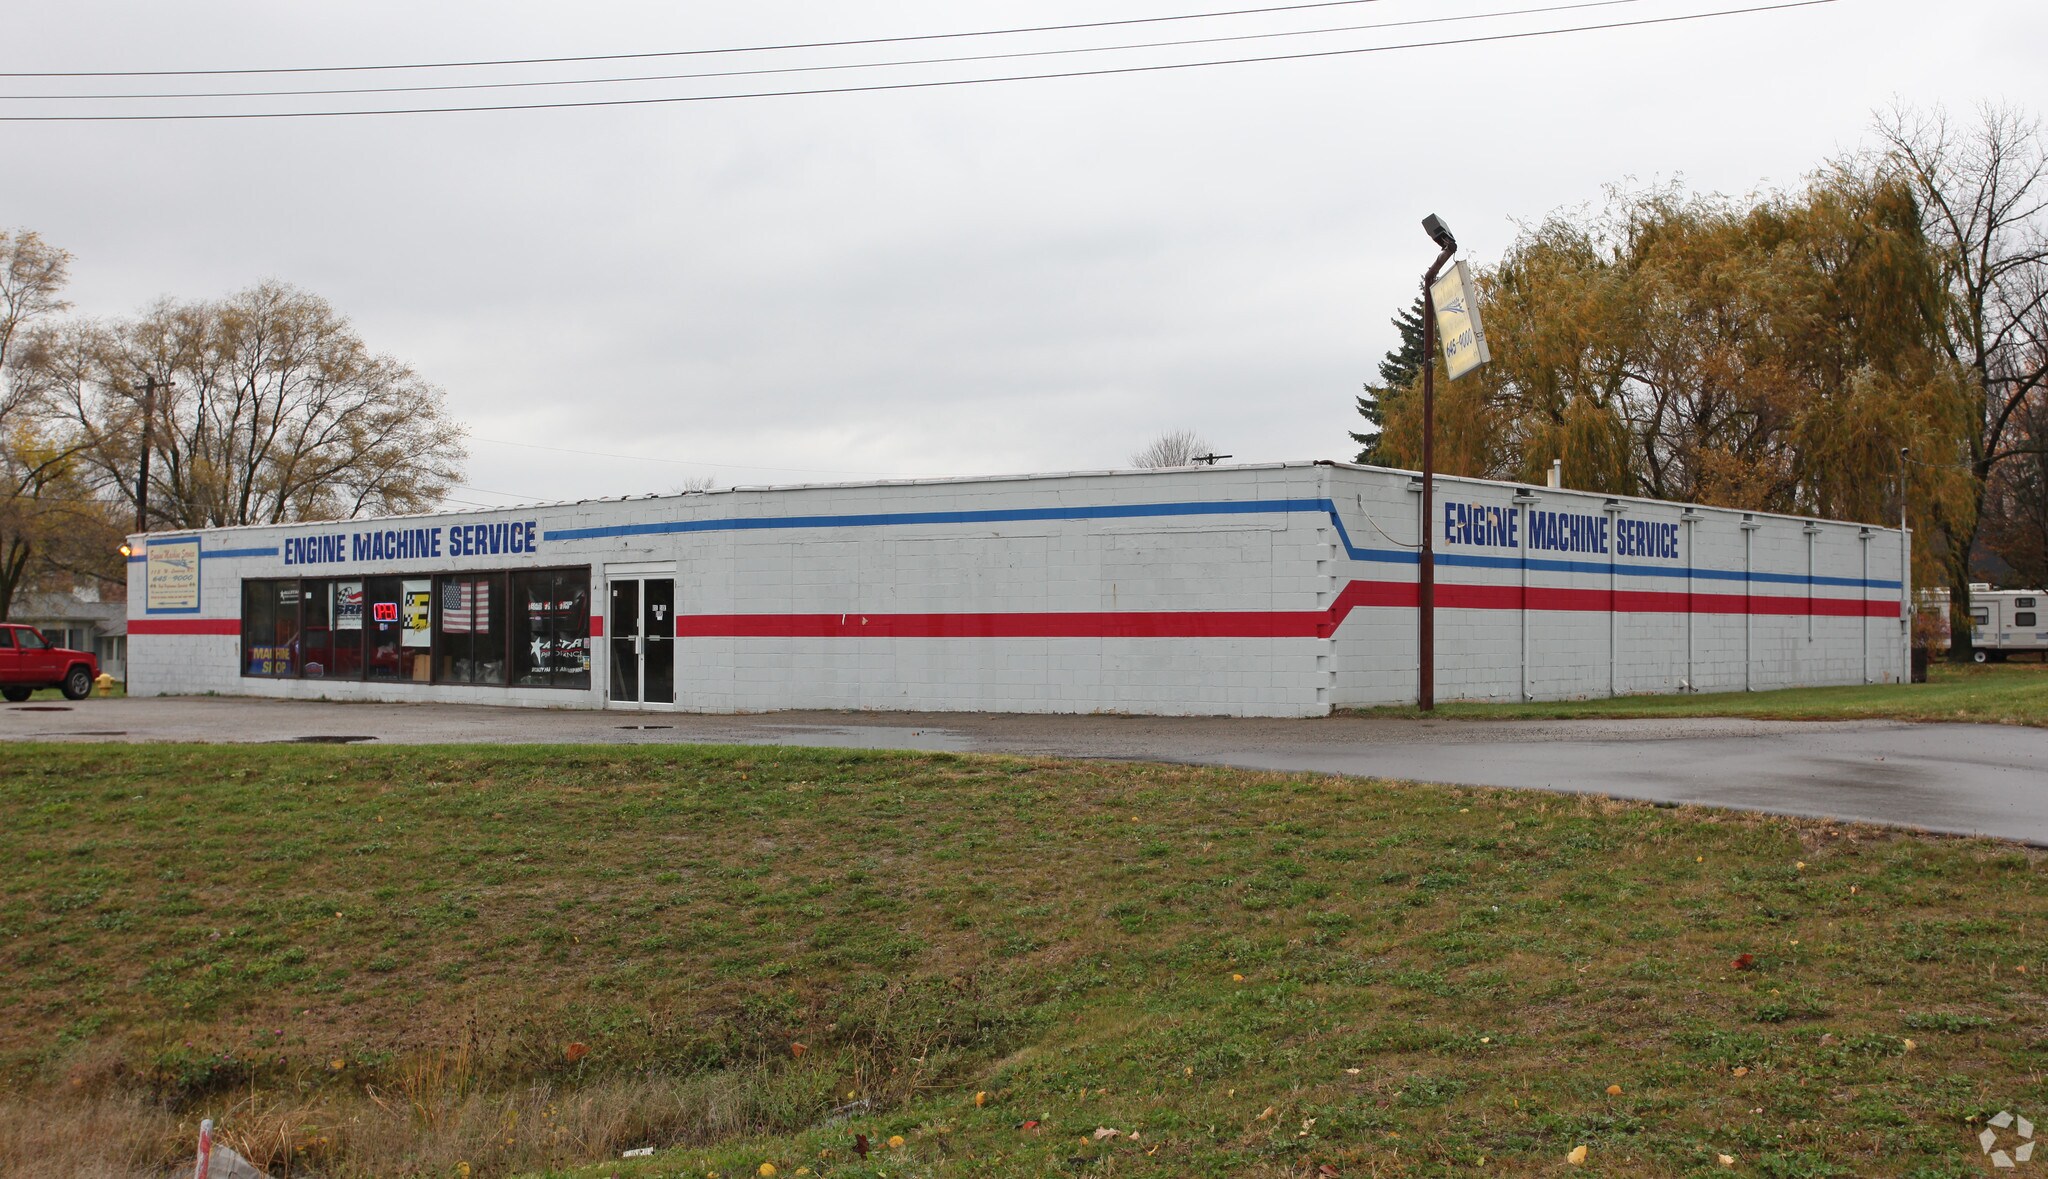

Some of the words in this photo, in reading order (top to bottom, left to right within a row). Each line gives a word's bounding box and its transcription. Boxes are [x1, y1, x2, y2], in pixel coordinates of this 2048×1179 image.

[284, 534, 346, 565] ENGINE
[352, 527, 442, 561] MACHINE
[450, 521, 537, 557] SERVICE
[1445, 502, 1518, 548] ENGINE
[1529, 510, 1608, 554] MACHINE
[1617, 518, 1679, 559] SERVICE
[253, 647, 290, 659] MAHINE
[262, 661, 286, 673] SOP
